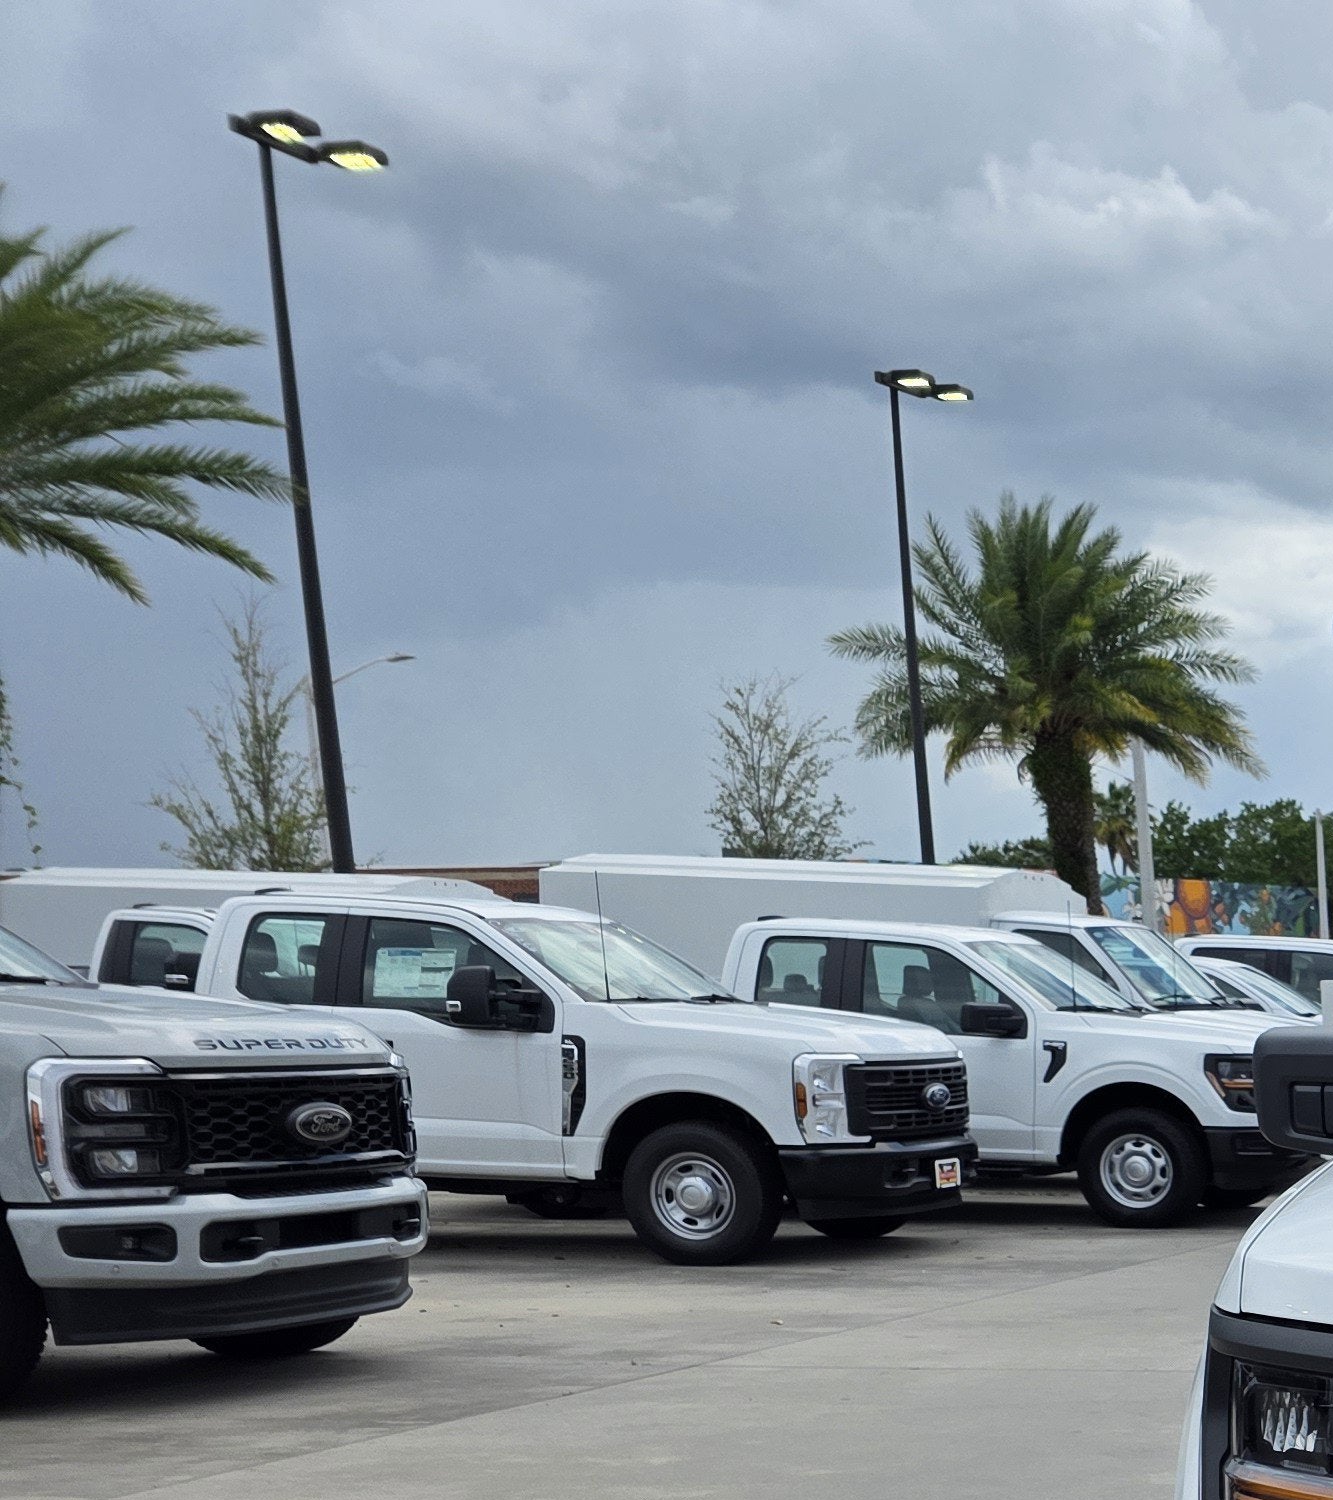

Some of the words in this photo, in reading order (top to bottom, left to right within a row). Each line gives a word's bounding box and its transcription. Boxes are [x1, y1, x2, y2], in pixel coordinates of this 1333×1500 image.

[193, 1038, 306, 1051] SUPER
[305, 1037, 369, 1049] DUTY
[310, 1113, 342, 1133] Ford
